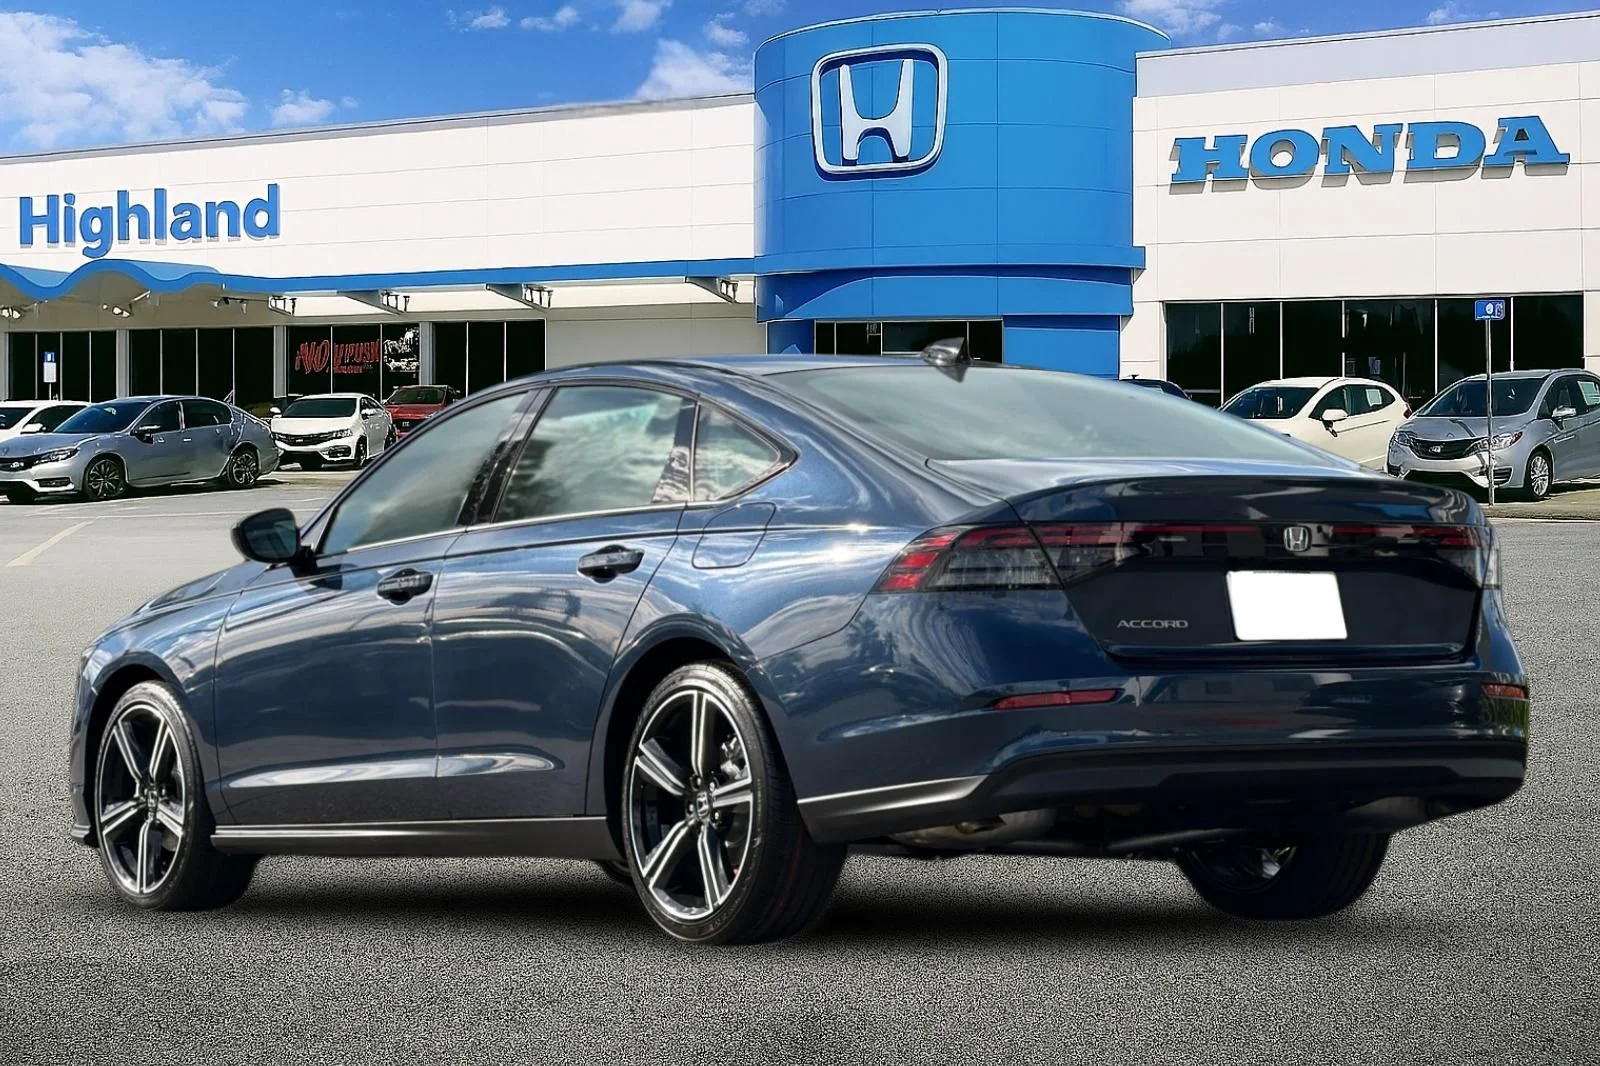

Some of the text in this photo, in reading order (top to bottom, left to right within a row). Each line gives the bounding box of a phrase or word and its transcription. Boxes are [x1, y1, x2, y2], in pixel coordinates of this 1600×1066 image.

[1171, 115, 1570, 184] HONDA
[19, 183, 279, 258] Highland
[1117, 619, 1189, 629] ACCORD
